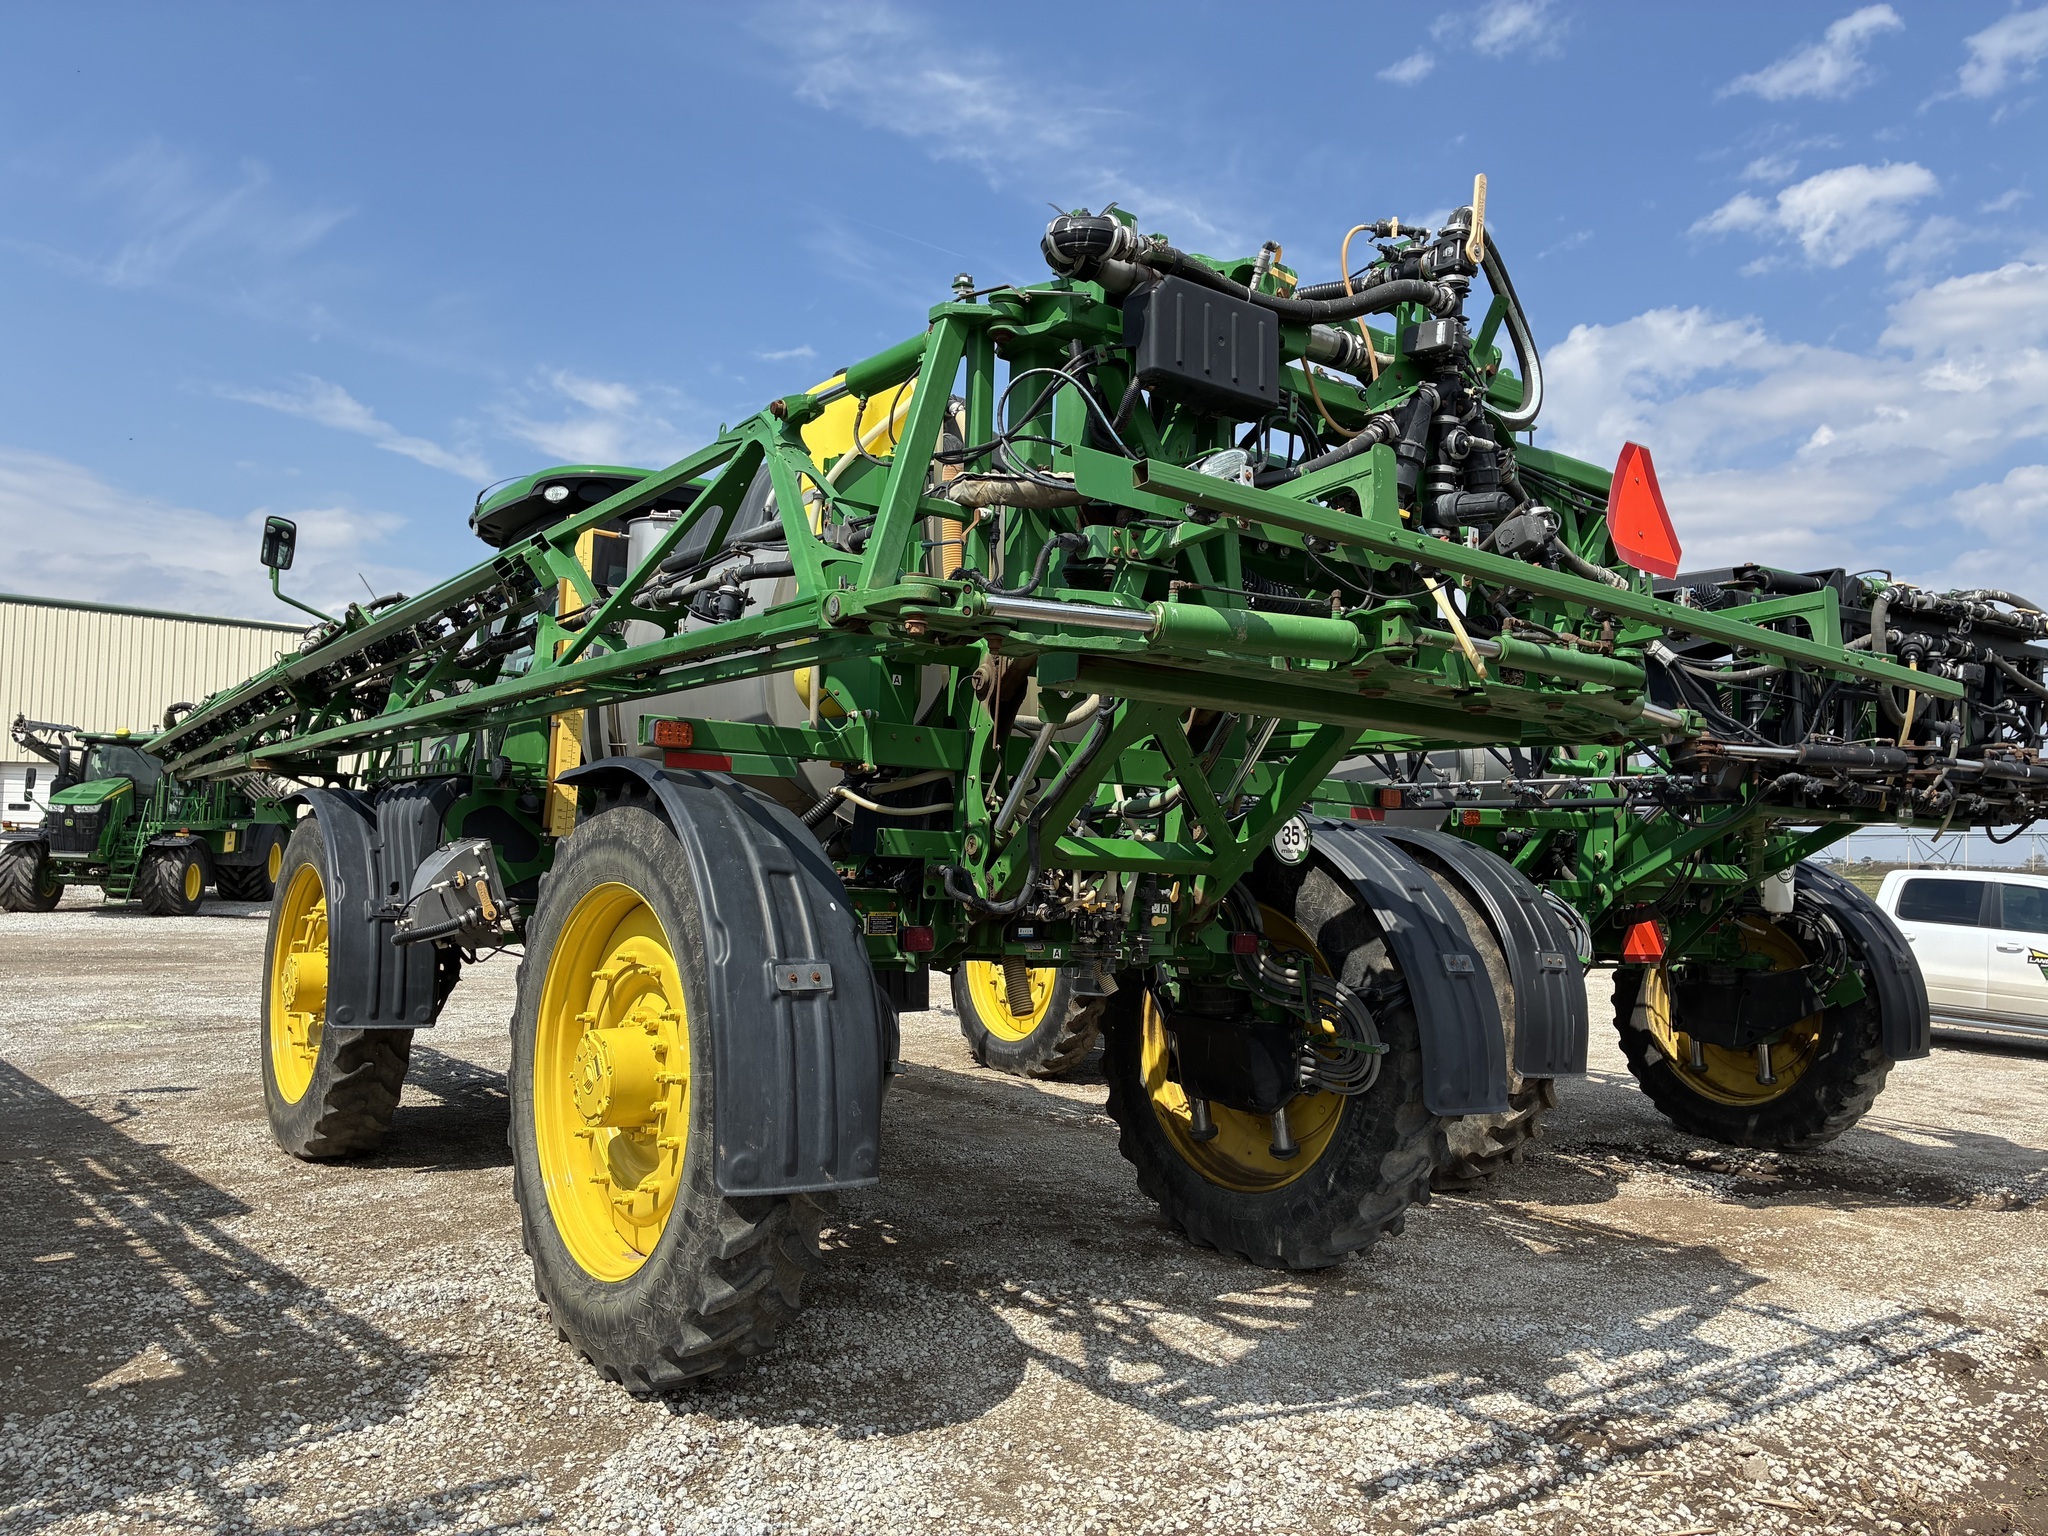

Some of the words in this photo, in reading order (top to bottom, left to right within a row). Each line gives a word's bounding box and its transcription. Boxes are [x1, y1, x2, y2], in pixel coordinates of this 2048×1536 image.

[893, 675, 901, 684] A
[1282, 825, 1300, 845] 35
[1162, 904, 1168, 912] A
[1053, 949, 1060, 957] A
